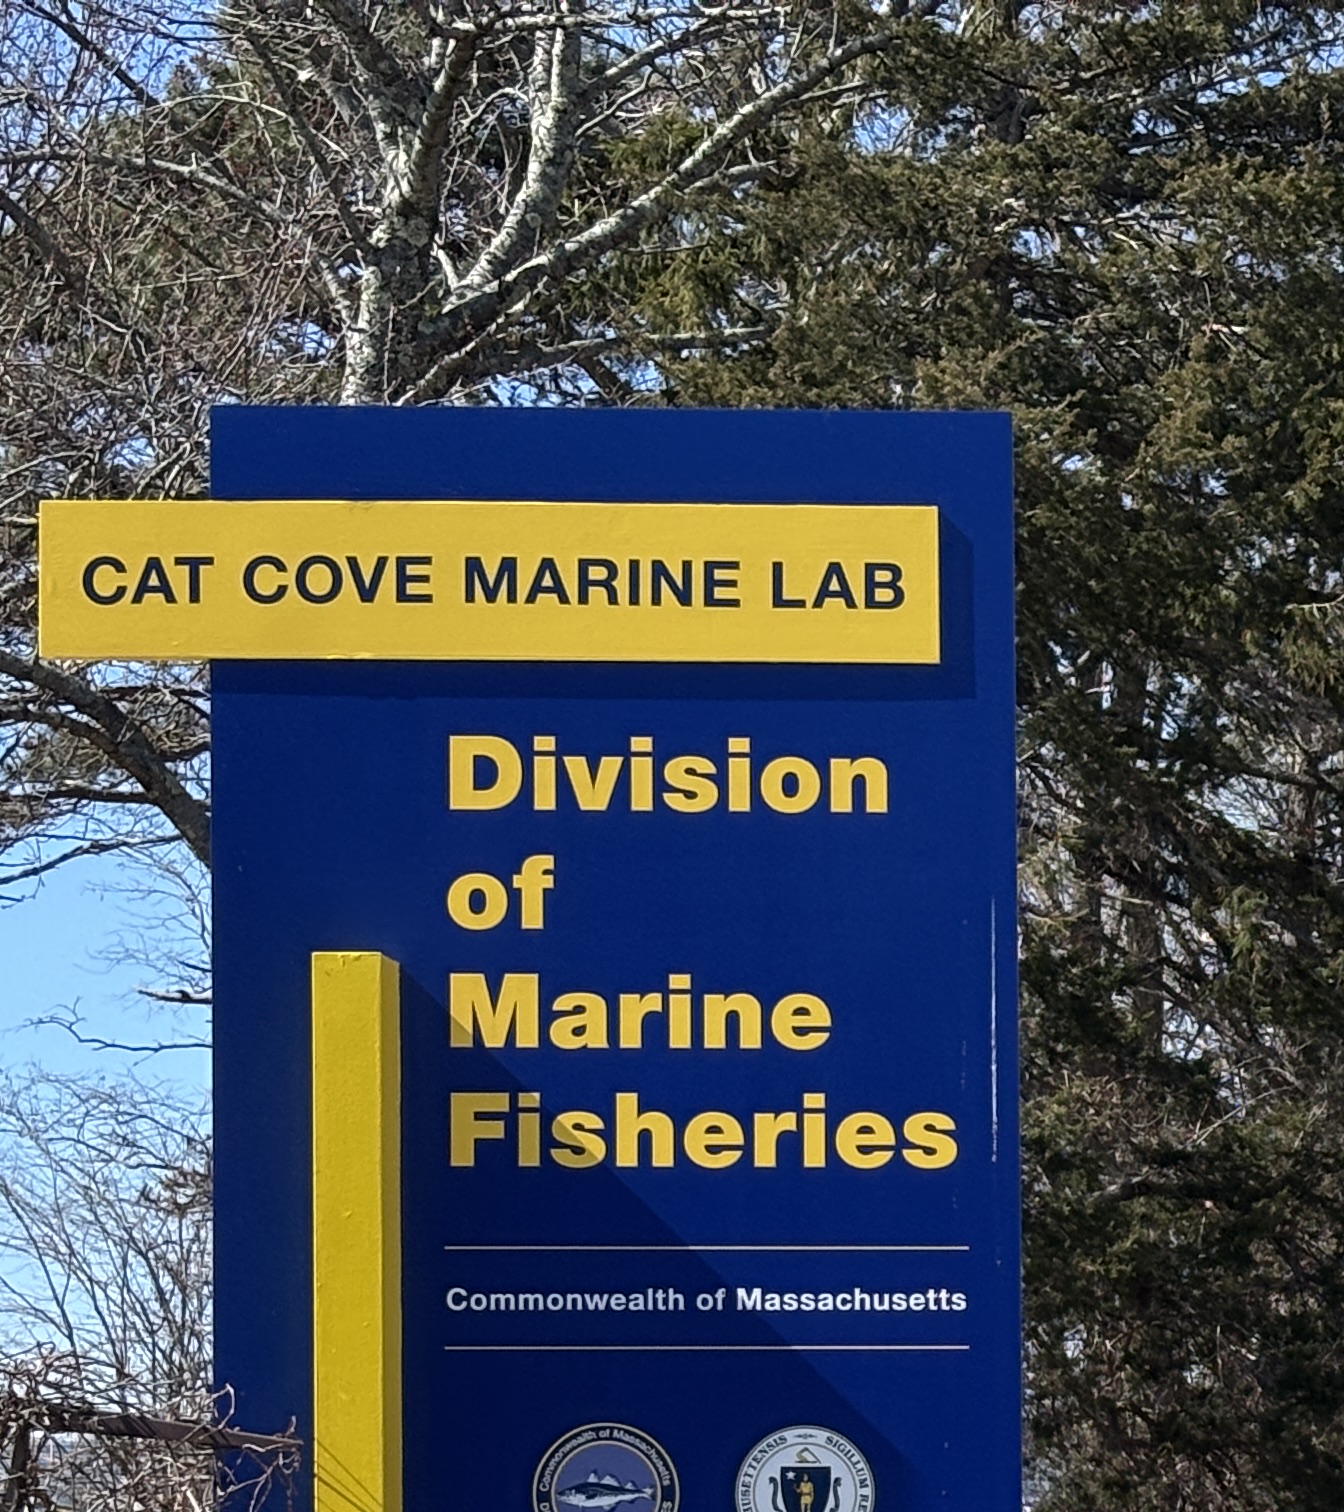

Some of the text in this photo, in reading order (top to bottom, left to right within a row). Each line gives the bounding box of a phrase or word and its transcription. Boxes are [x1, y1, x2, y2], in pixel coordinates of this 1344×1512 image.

[82, 555, 906, 610] CAT COVE MARINE LAB
[448, 735, 889, 814] Division
[446, 854, 556, 931] of
[449, 972, 832, 1051] Marine
[449, 1091, 959, 1170] Fisheries
[446, 1287, 967, 1312] Commonwealth of Massachusetts
[539, 1429, 671, 1492] Commonwealth of Massachusetts
[825, 1435, 869, 1489] SIGILLUM
